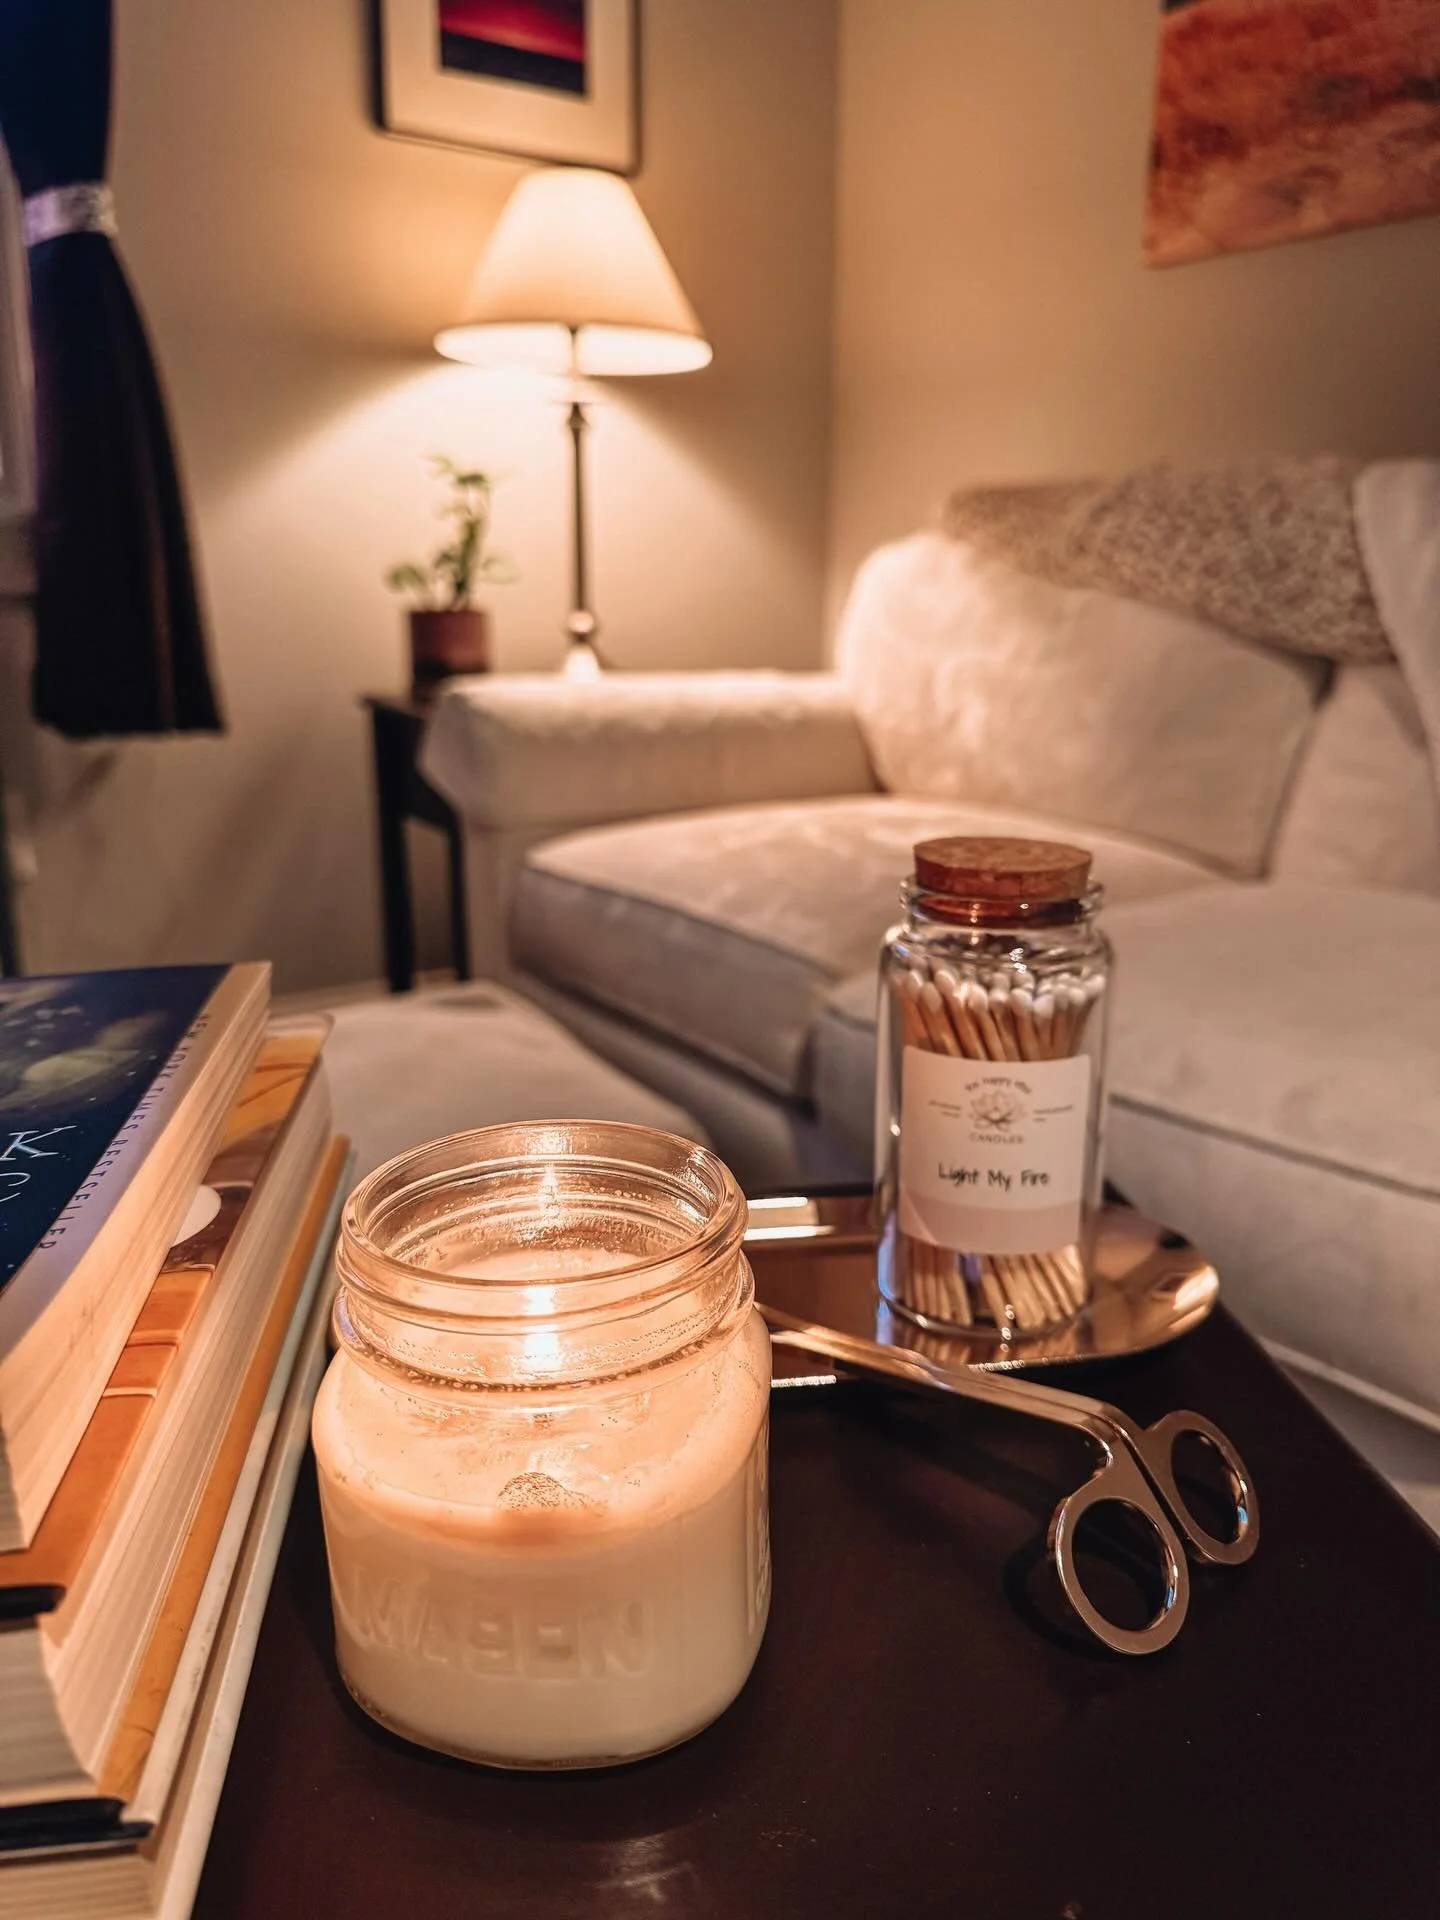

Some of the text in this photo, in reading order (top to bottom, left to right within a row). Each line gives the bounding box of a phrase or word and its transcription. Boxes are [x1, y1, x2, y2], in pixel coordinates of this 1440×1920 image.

[121, 1085, 165, 1130] TIMES
[968, 1132, 1026, 1144] CANDLES
[938, 1161, 1050, 1192] Light My Fire
